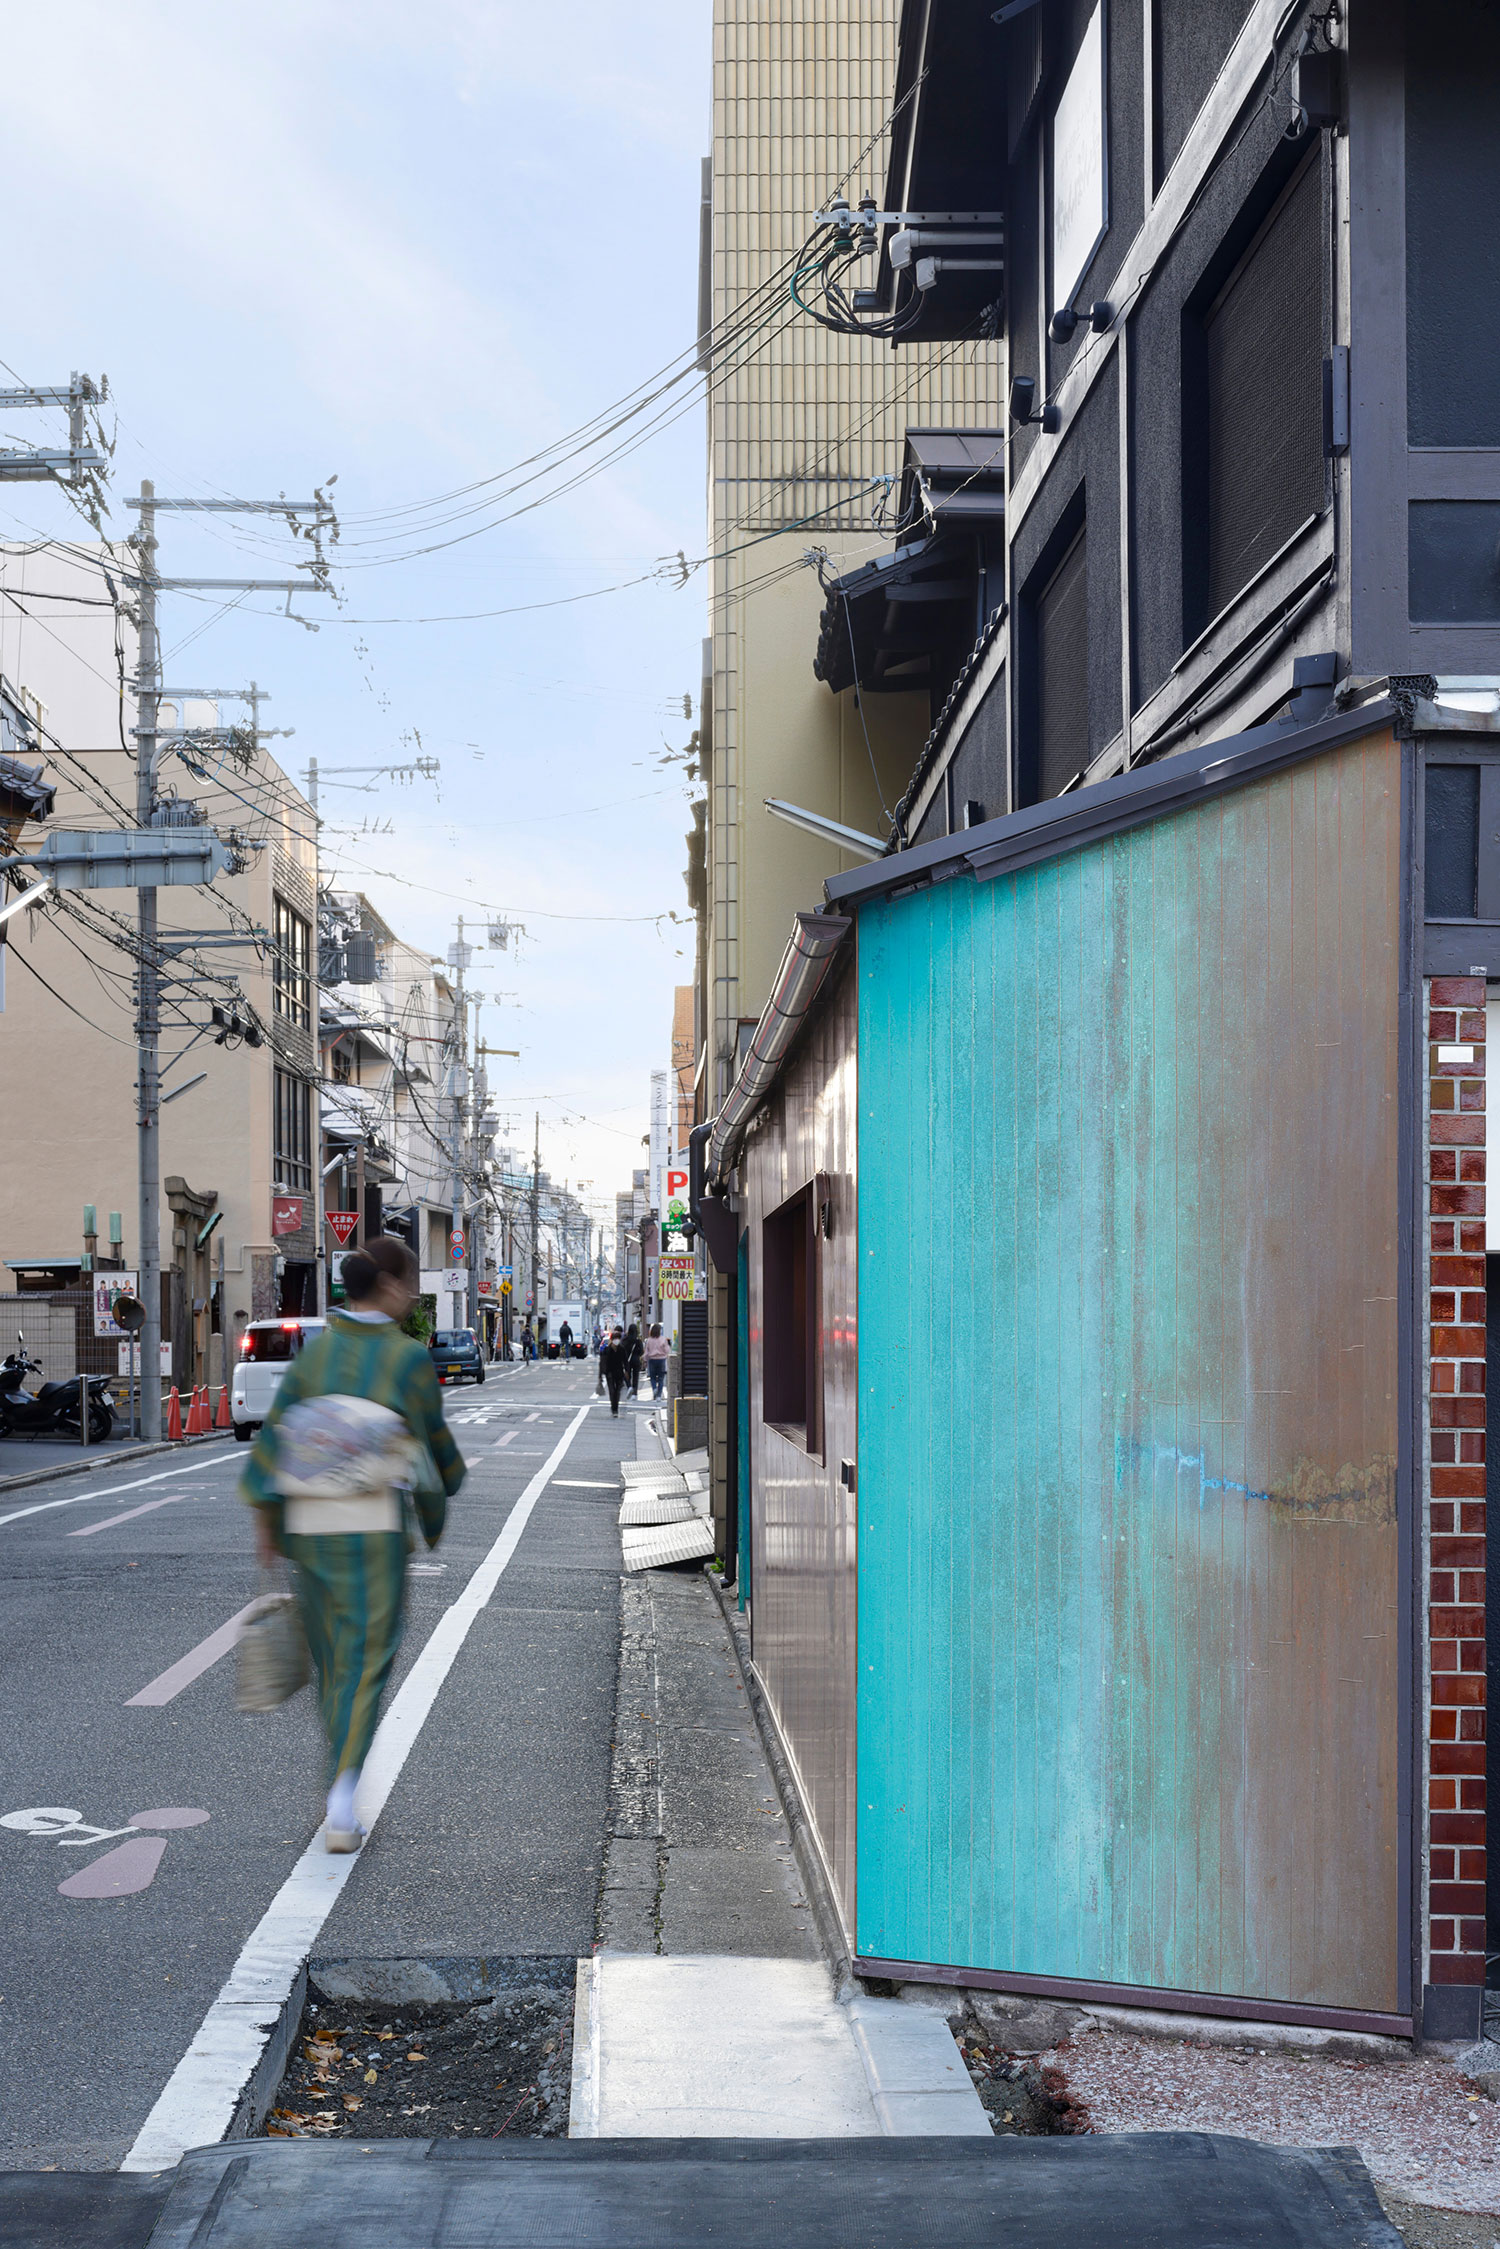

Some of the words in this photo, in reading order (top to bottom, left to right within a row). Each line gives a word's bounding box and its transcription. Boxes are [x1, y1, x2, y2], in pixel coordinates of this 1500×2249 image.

[667, 1171, 688, 1197] P
[332, 1214, 354, 1223] 止まれ
[661, 1270, 692, 1279] 8時間最大
